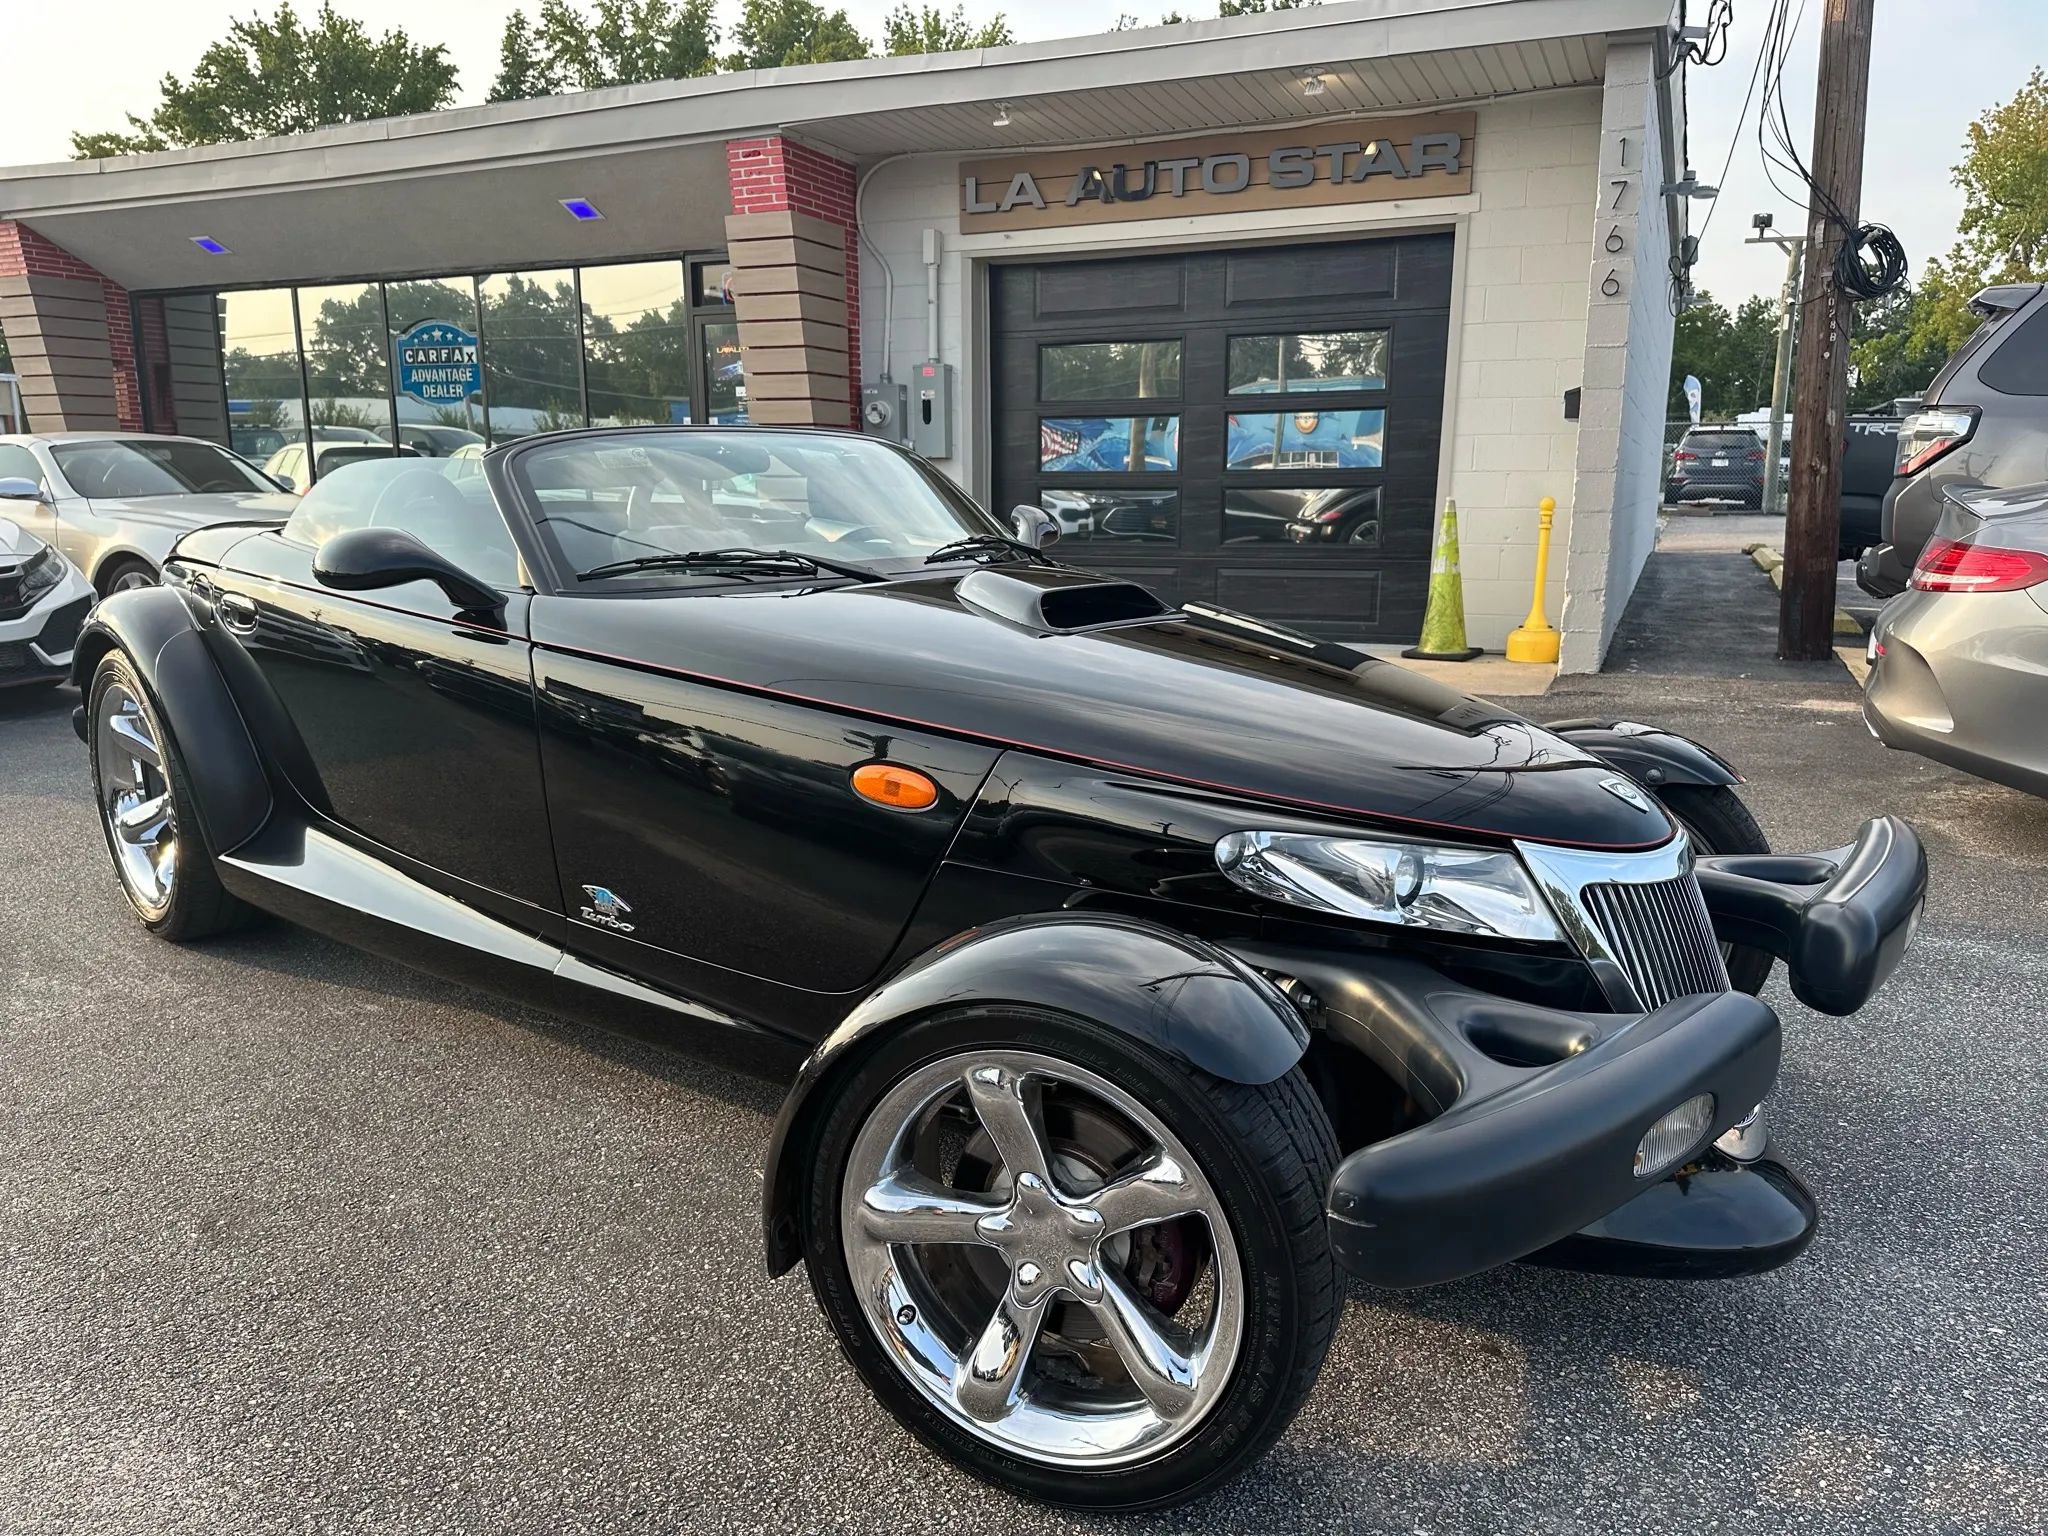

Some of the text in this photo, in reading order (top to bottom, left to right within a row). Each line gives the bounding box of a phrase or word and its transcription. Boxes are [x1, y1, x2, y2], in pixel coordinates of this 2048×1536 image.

[965, 132, 1462, 214] LA AUTO STAR
[1601, 136, 1628, 297] 1766
[405, 348, 475, 364] CARFAX
[411, 368, 474, 383] ADVANTAGE
[422, 384, 464, 398] DEALER
